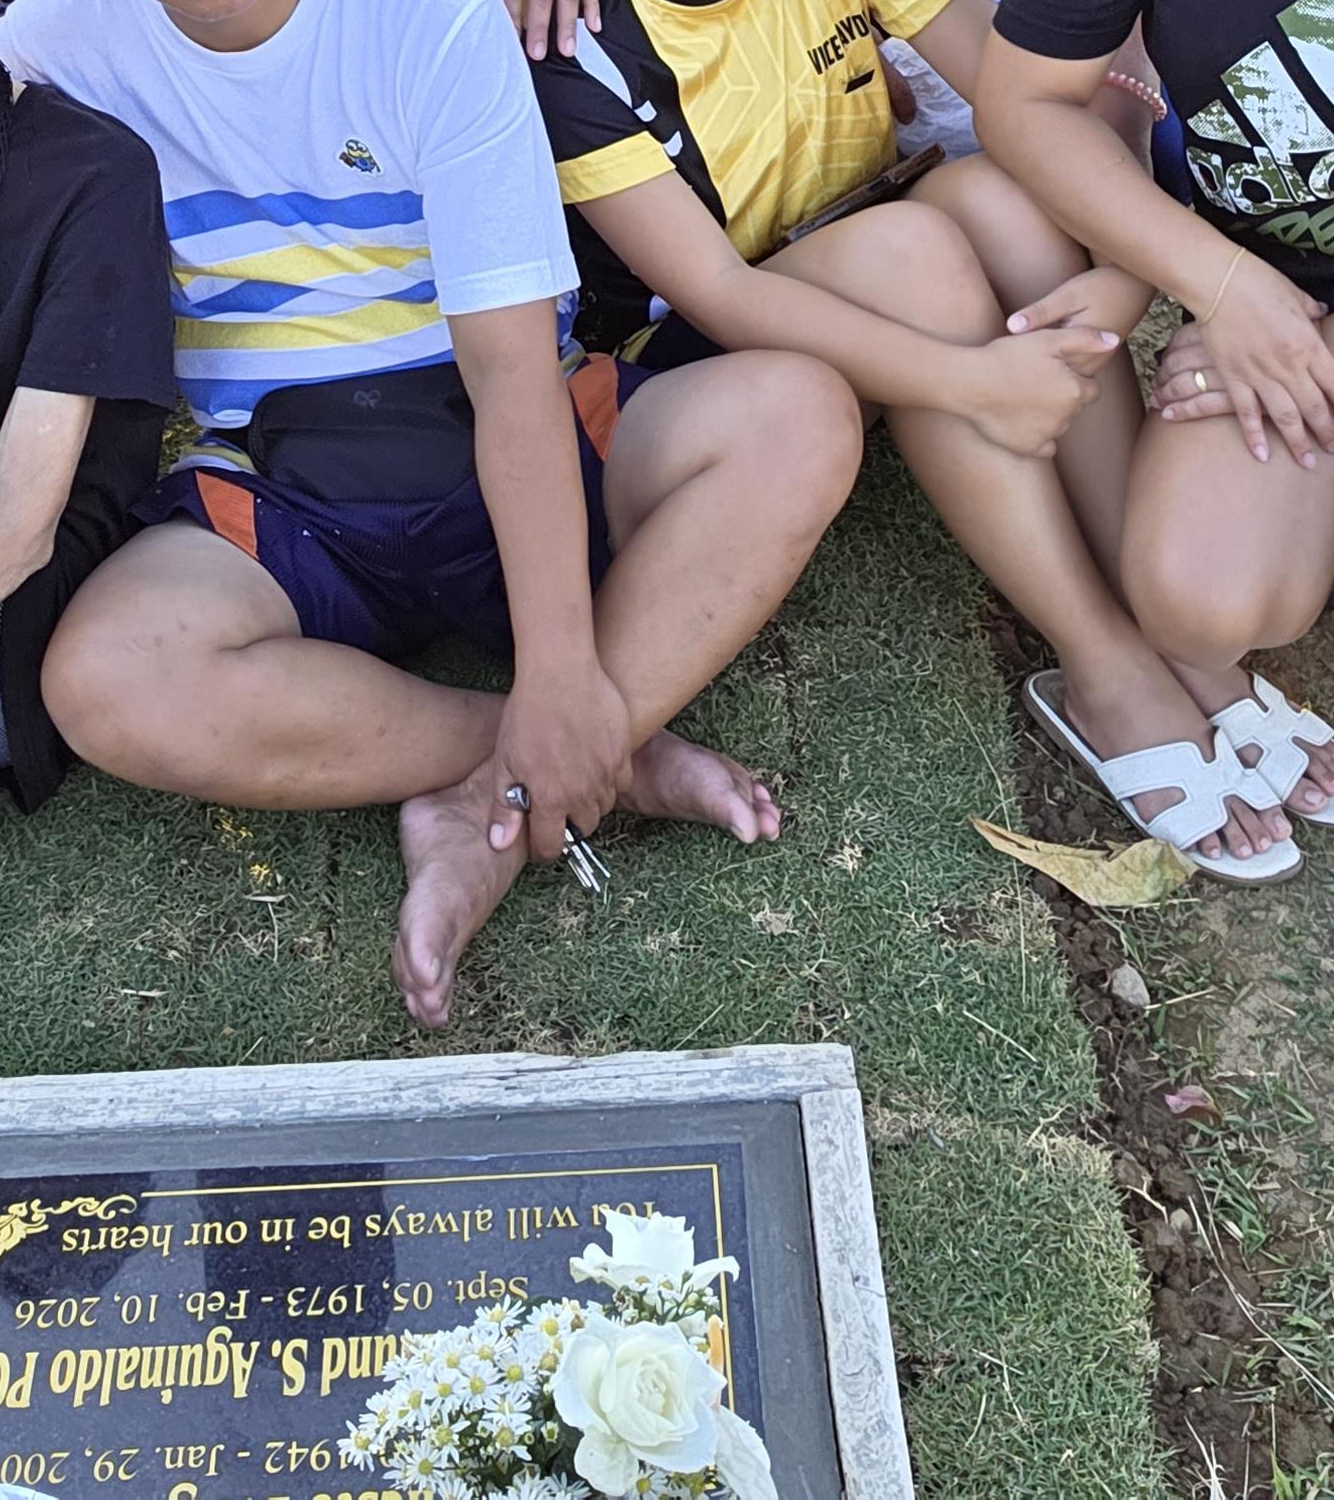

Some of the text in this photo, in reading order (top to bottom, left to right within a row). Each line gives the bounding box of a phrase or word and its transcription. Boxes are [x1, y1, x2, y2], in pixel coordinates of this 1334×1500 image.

[806, 33, 845, 76] VICE
[61, 1223, 174, 1257] hearts
[184, 1219, 249, 1247] our
[259, 1217, 296, 1252] in
[307, 1214, 353, 1249] be
[364, 1203, 493, 1244] always
[508, 1205, 579, 1240] will
[285, 1283, 366, 1318] 1973
[381, 1278, 433, 1312] 05,
[446, 1270, 529, 1304] Sept.
[15, 1296, 102, 1330] 2026
[113, 1293, 159, 1325] 10,
[178, 1288, 250, 1322] Feb.
[49, 1326, 261, 1408] Aguinaldo
[271, 1338, 309, 1398] S.
[82, 1446, 140, 1483] 29,
[154, 1441, 227, 1479] Jan.
